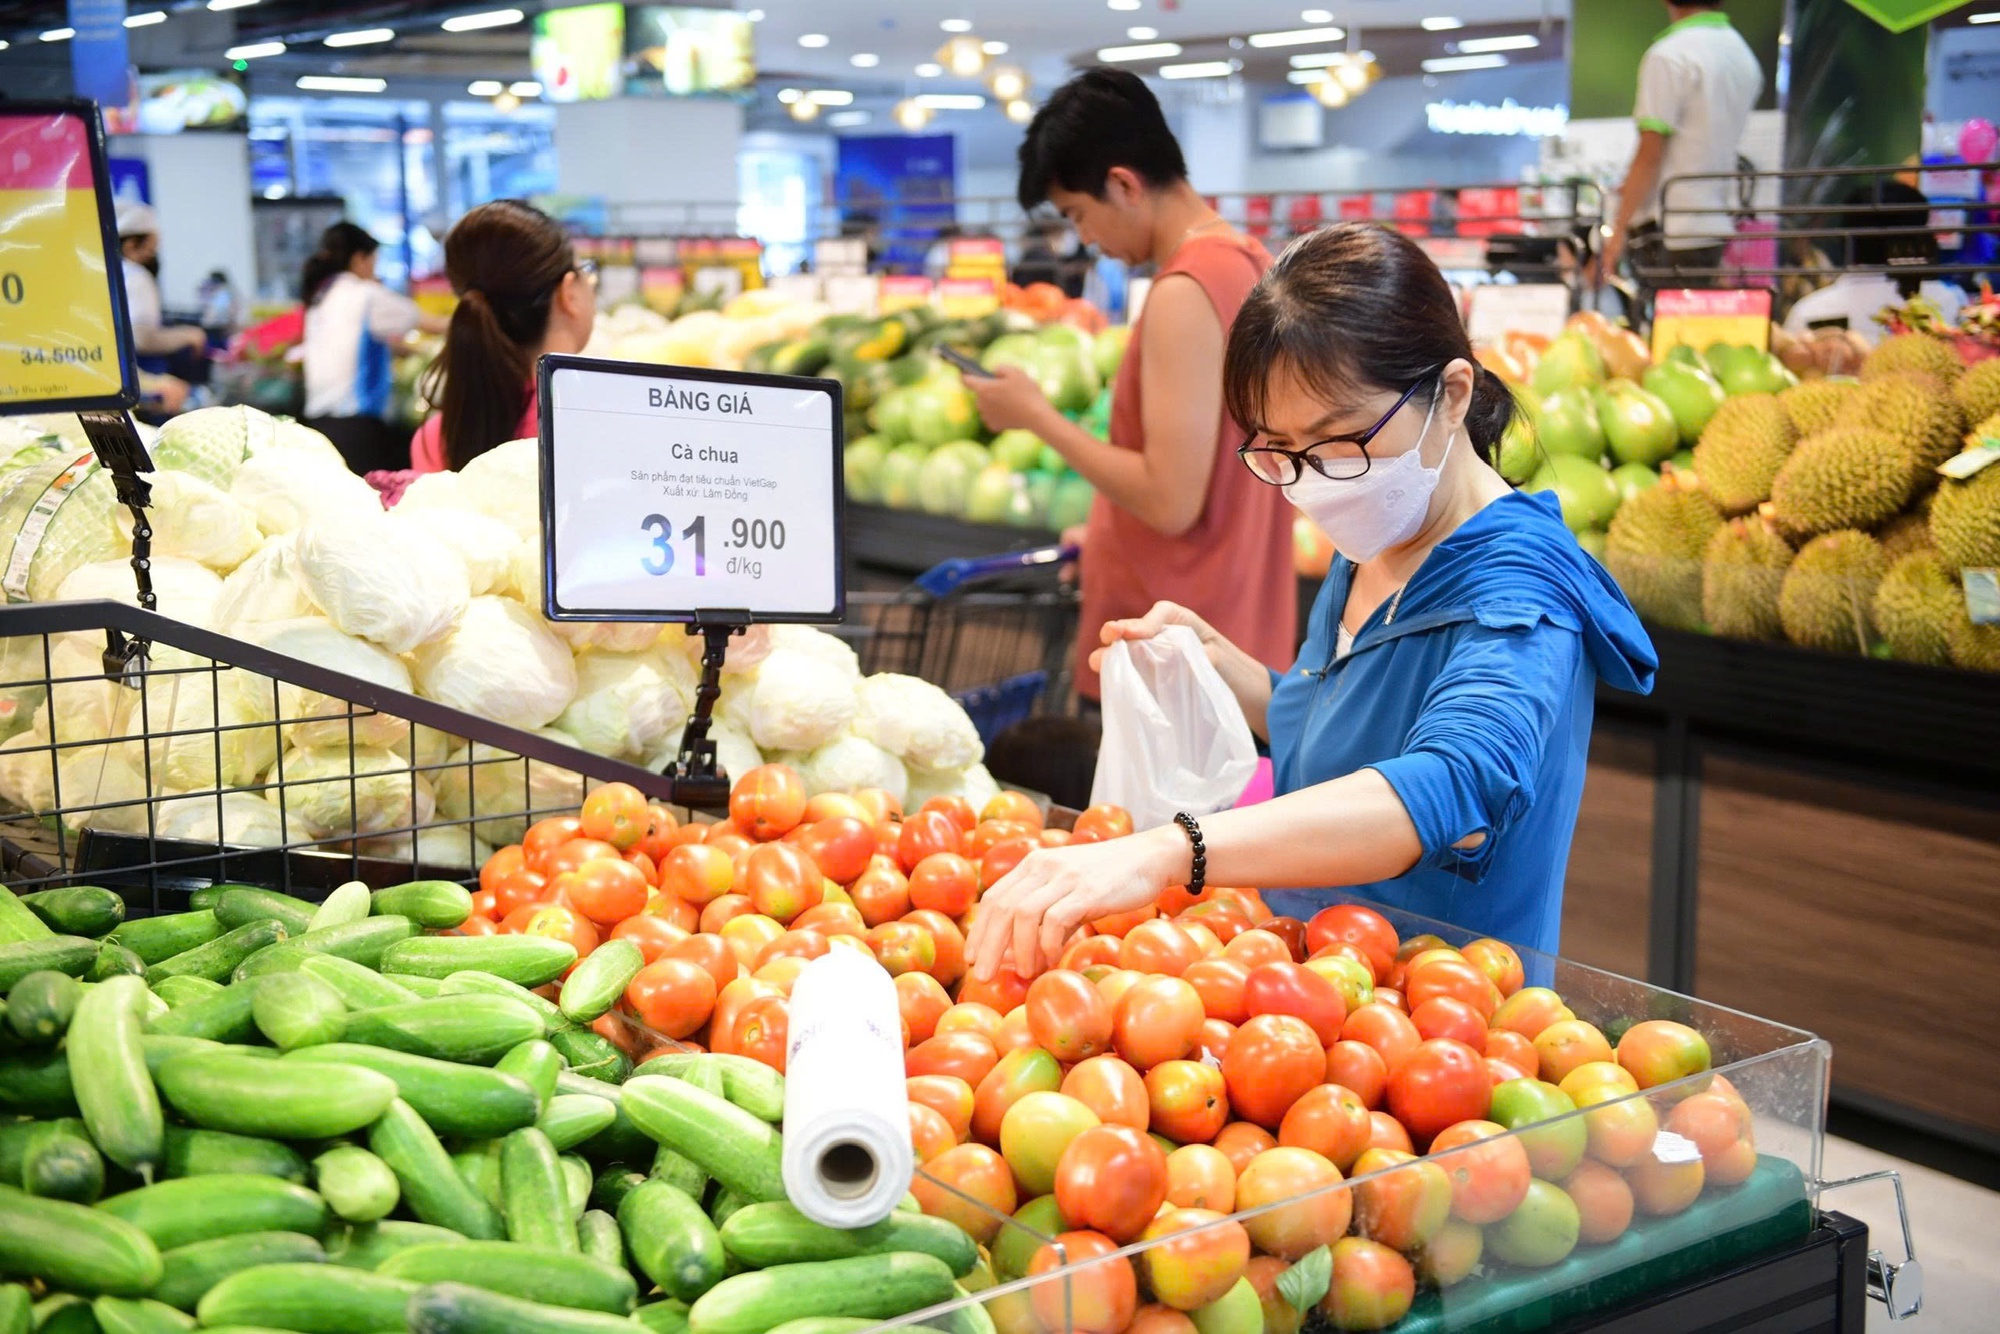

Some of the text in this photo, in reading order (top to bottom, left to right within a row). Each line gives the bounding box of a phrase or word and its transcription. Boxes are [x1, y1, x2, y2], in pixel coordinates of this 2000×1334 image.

[649, 385, 753, 415] BẢNG GIÁ
[671, 443, 738, 463] Cà chua
[631, 470, 777, 489] Sản phẩm đạt tiêu chuẩn VietGap
[663, 485, 684, 497] Xuất
[703, 488, 722, 499] Lâm
[724, 489, 748, 502] Đồng
[641, 513, 786, 576] 31 .900
[726, 556, 763, 579] đ/kg
